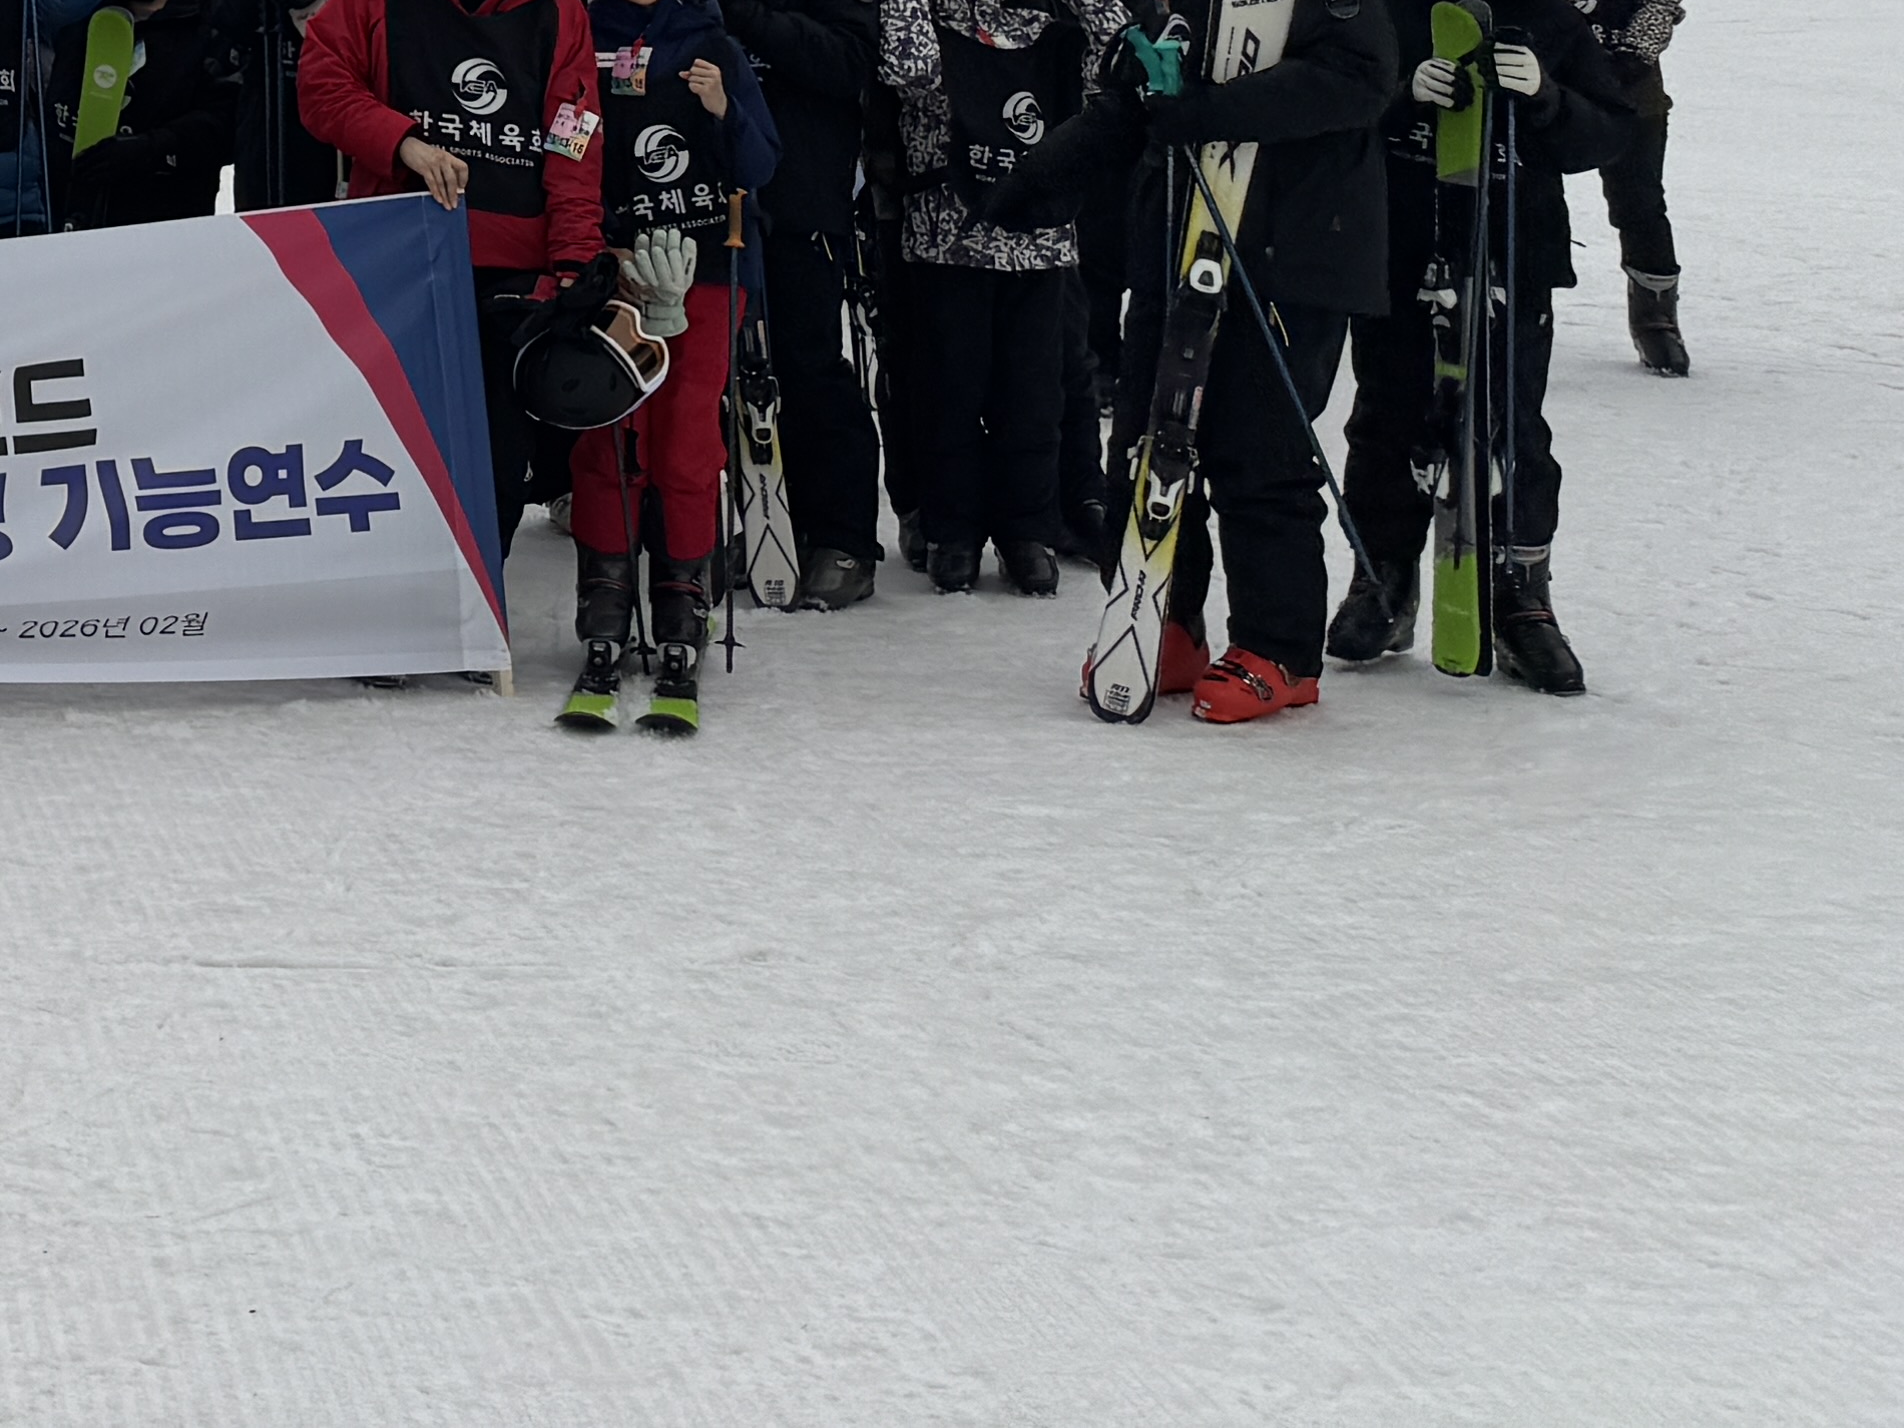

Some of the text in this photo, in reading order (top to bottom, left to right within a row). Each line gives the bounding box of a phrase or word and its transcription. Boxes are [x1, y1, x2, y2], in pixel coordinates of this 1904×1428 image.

[41, 438, 402, 552] 기능연수
[18, 616, 130, 642] 2026년
[139, 611, 209, 638] 02월
